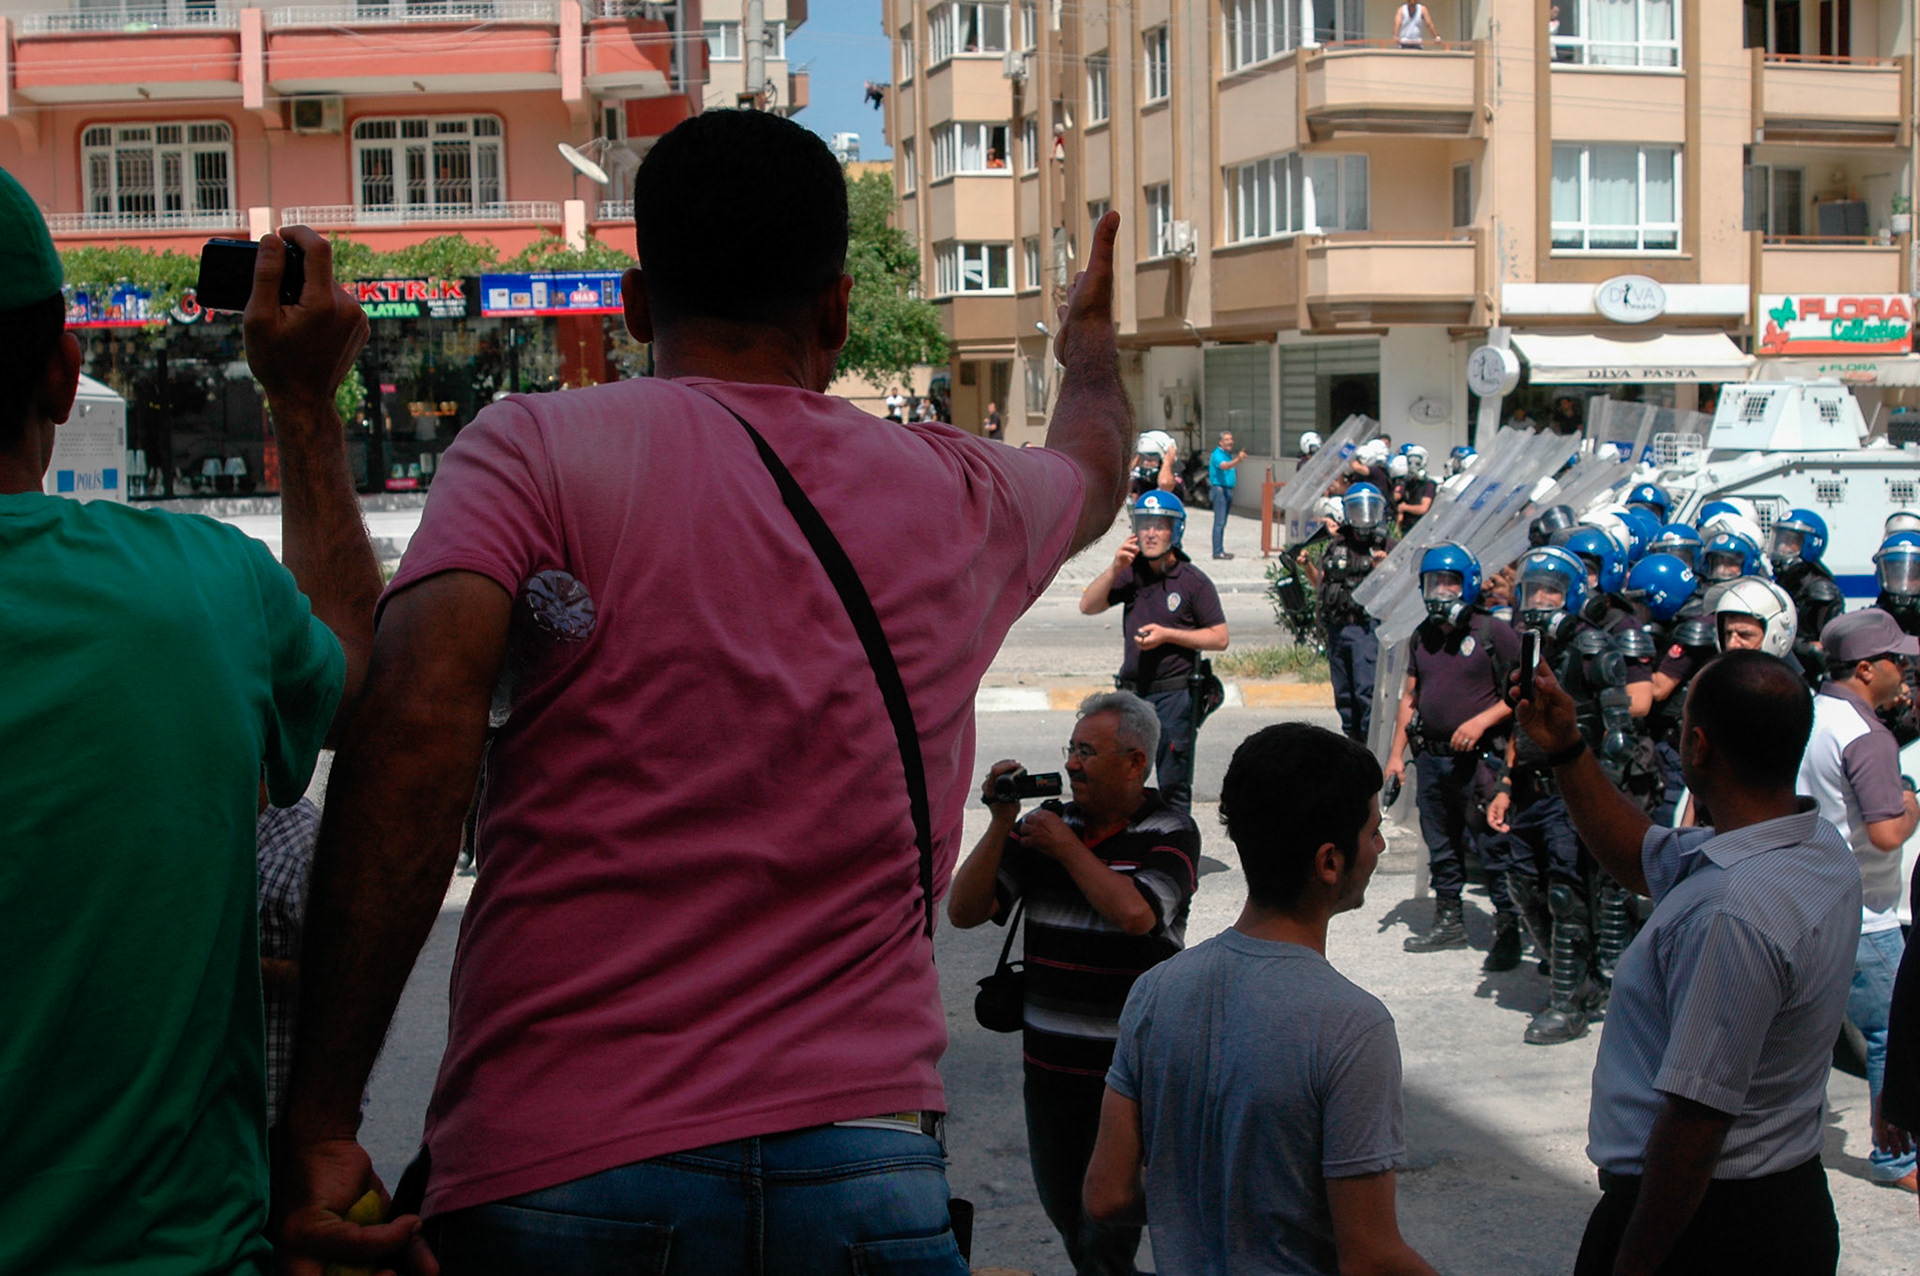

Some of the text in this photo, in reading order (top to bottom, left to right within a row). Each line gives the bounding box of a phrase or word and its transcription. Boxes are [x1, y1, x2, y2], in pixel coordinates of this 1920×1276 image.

[1799, 298, 1910, 321] FLORA
[1830, 363, 1877, 371] FLORA
[1643, 369, 1697, 378] PASTA
[1613, 562, 1623, 573] 31
[1654, 590, 1667, 604] 31
